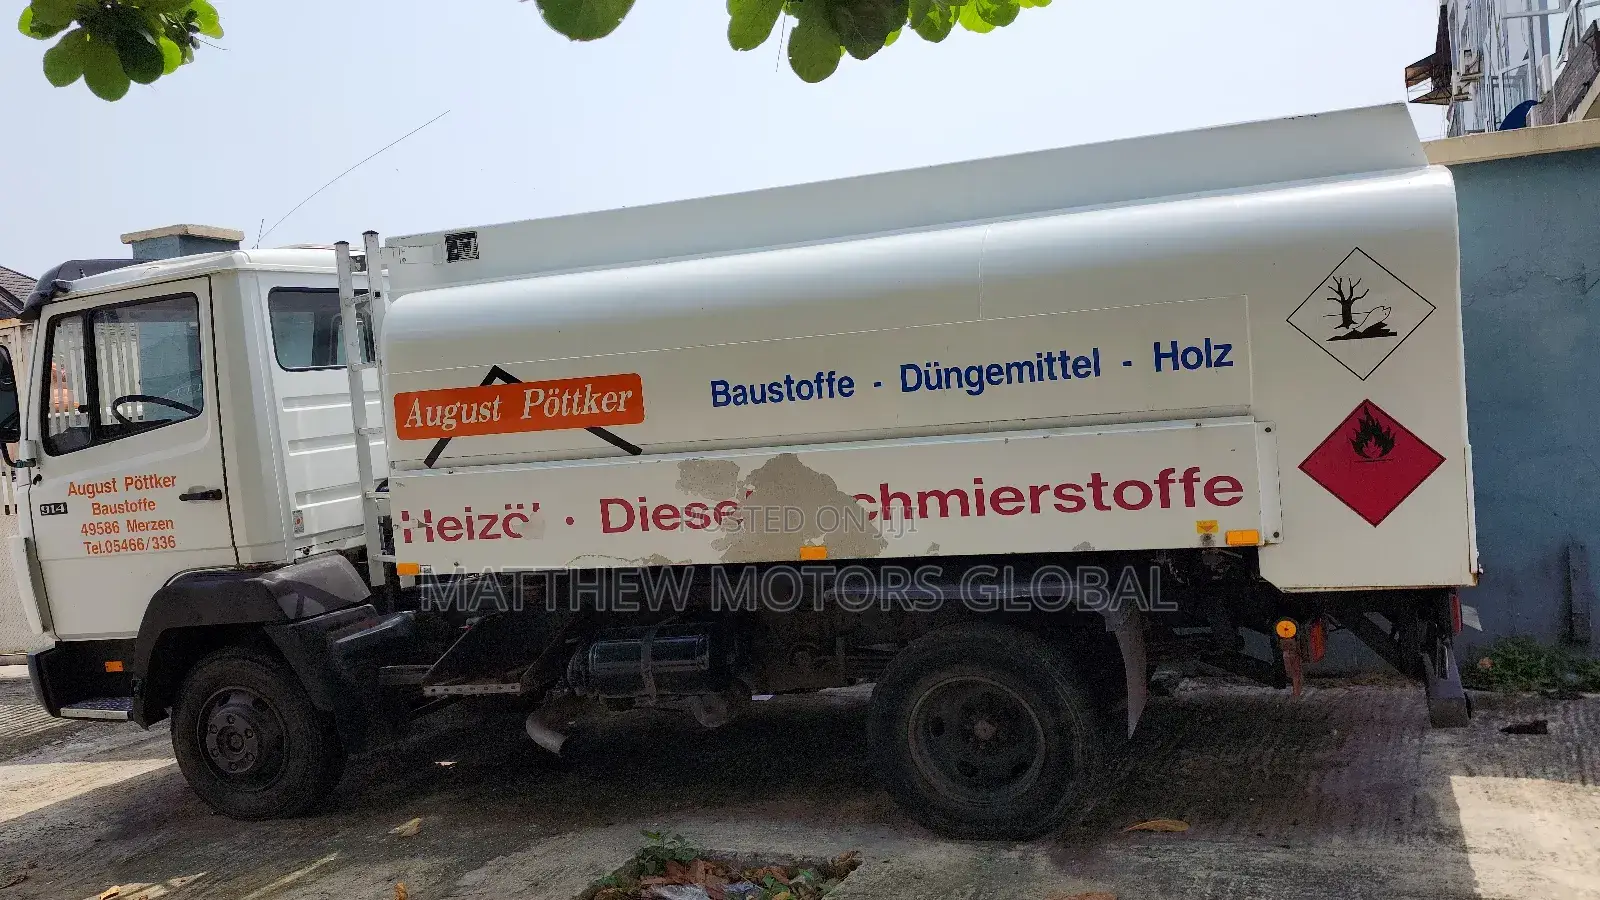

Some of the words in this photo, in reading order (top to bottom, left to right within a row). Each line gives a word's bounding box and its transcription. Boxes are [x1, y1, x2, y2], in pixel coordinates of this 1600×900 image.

[710, 370, 855, 408] Baustoffe
[900, 347, 1101, 396] Düngemittel
[1153, 337, 1234, 372] Holz
[404, 395, 503, 431] August
[520, 384, 633, 420] Pöttker
[67, 476, 118, 500] August
[124, 473, 177, 492] Pöttker
[40, 503, 67, 515] 914
[91, 498, 157, 516] Baustoffe
[401, 502, 541, 544] Heizö
[599, 490, 754, 534] Diese
[852, 466, 1244, 521] chmierstoffe
[80, 521, 120, 536] 49586
[126, 518, 175, 533] Merzen
[84, 535, 176, 555] Tel.05466/336
